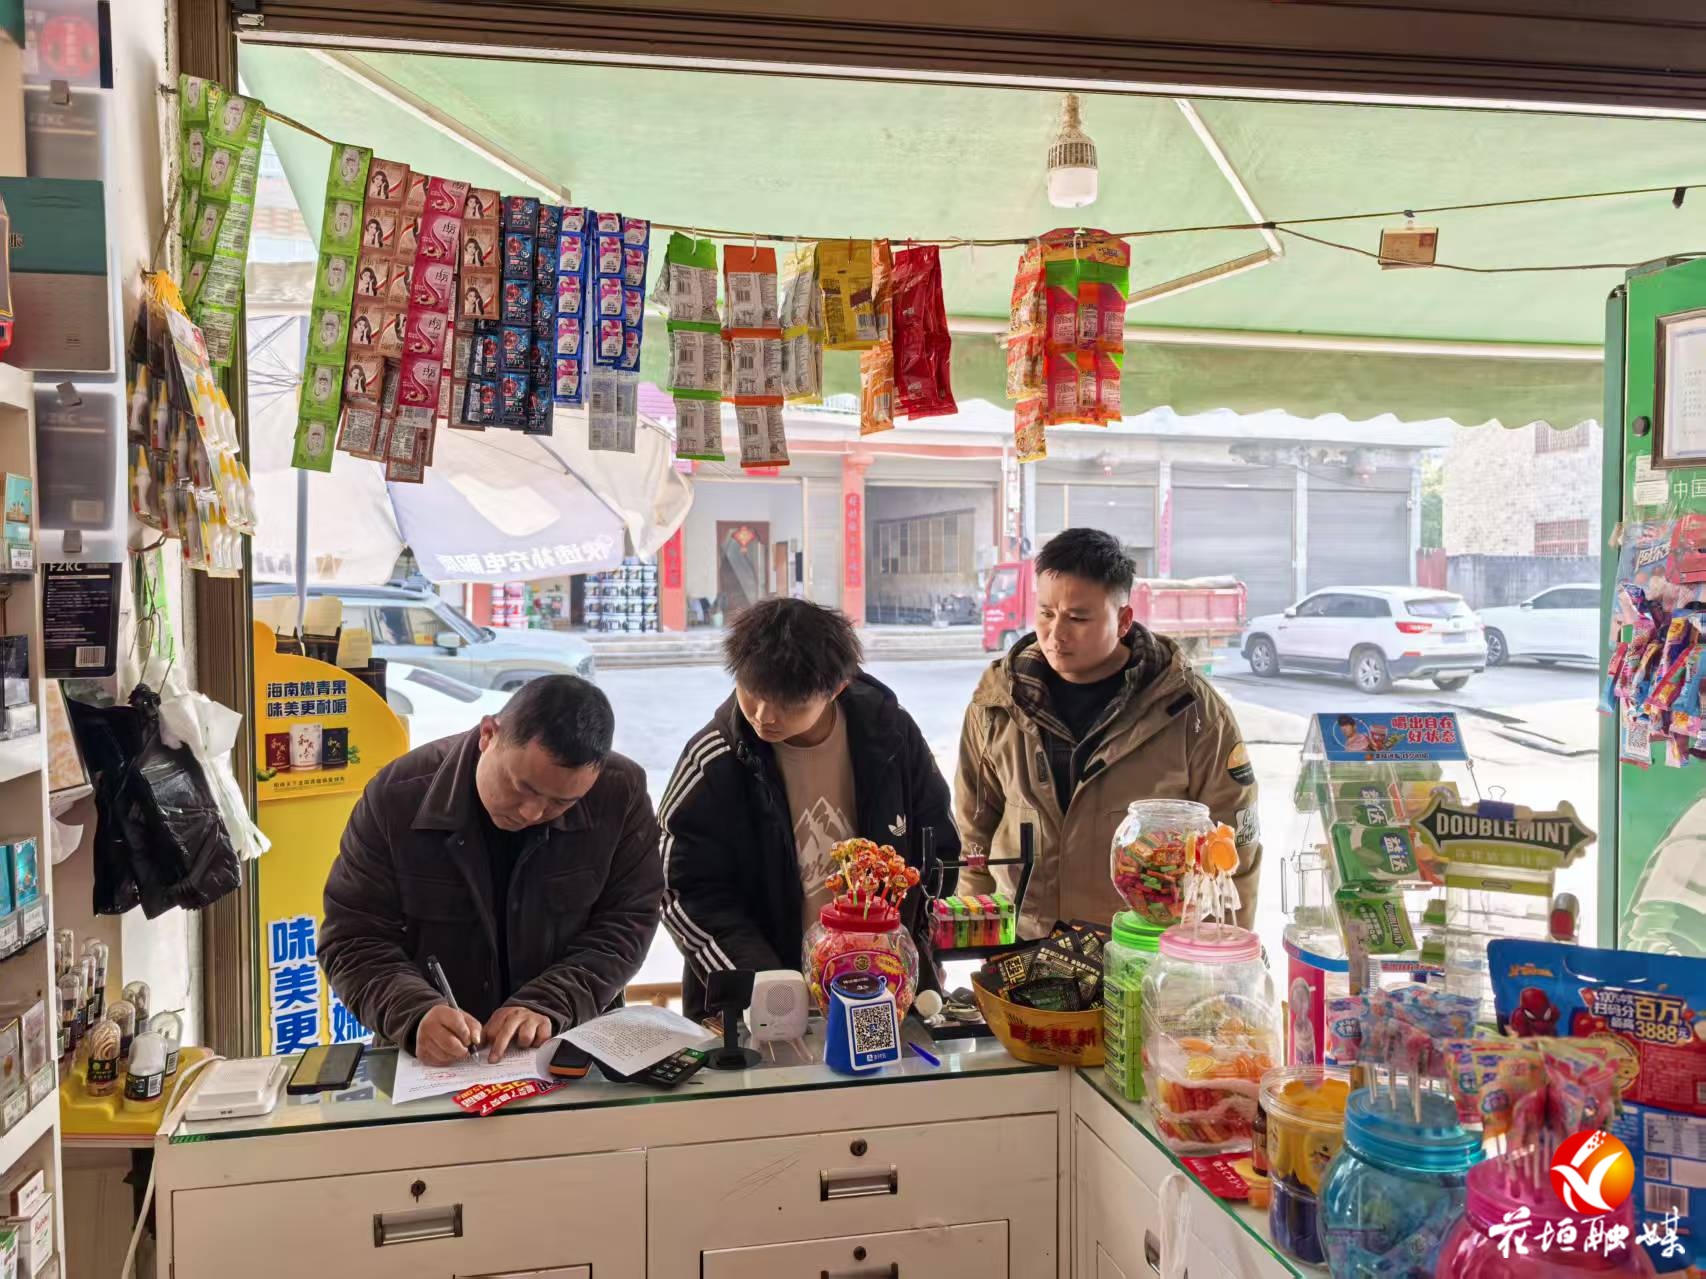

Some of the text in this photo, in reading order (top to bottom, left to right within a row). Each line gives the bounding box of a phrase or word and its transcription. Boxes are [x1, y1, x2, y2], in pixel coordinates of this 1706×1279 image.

[49, 562, 83, 572] FZKC
[266, 680, 347, 698] 海南嫩青果
[266, 698, 347, 717] 味美更耐嚼
[1391, 716, 1454, 730] 嚼出自在
[1408, 729, 1457, 743] 好状态
[1436, 812, 1573, 846] DOUBLEMINT
[1384, 835, 1410, 873] 益达
[272, 917, 319, 1055] 味美更
